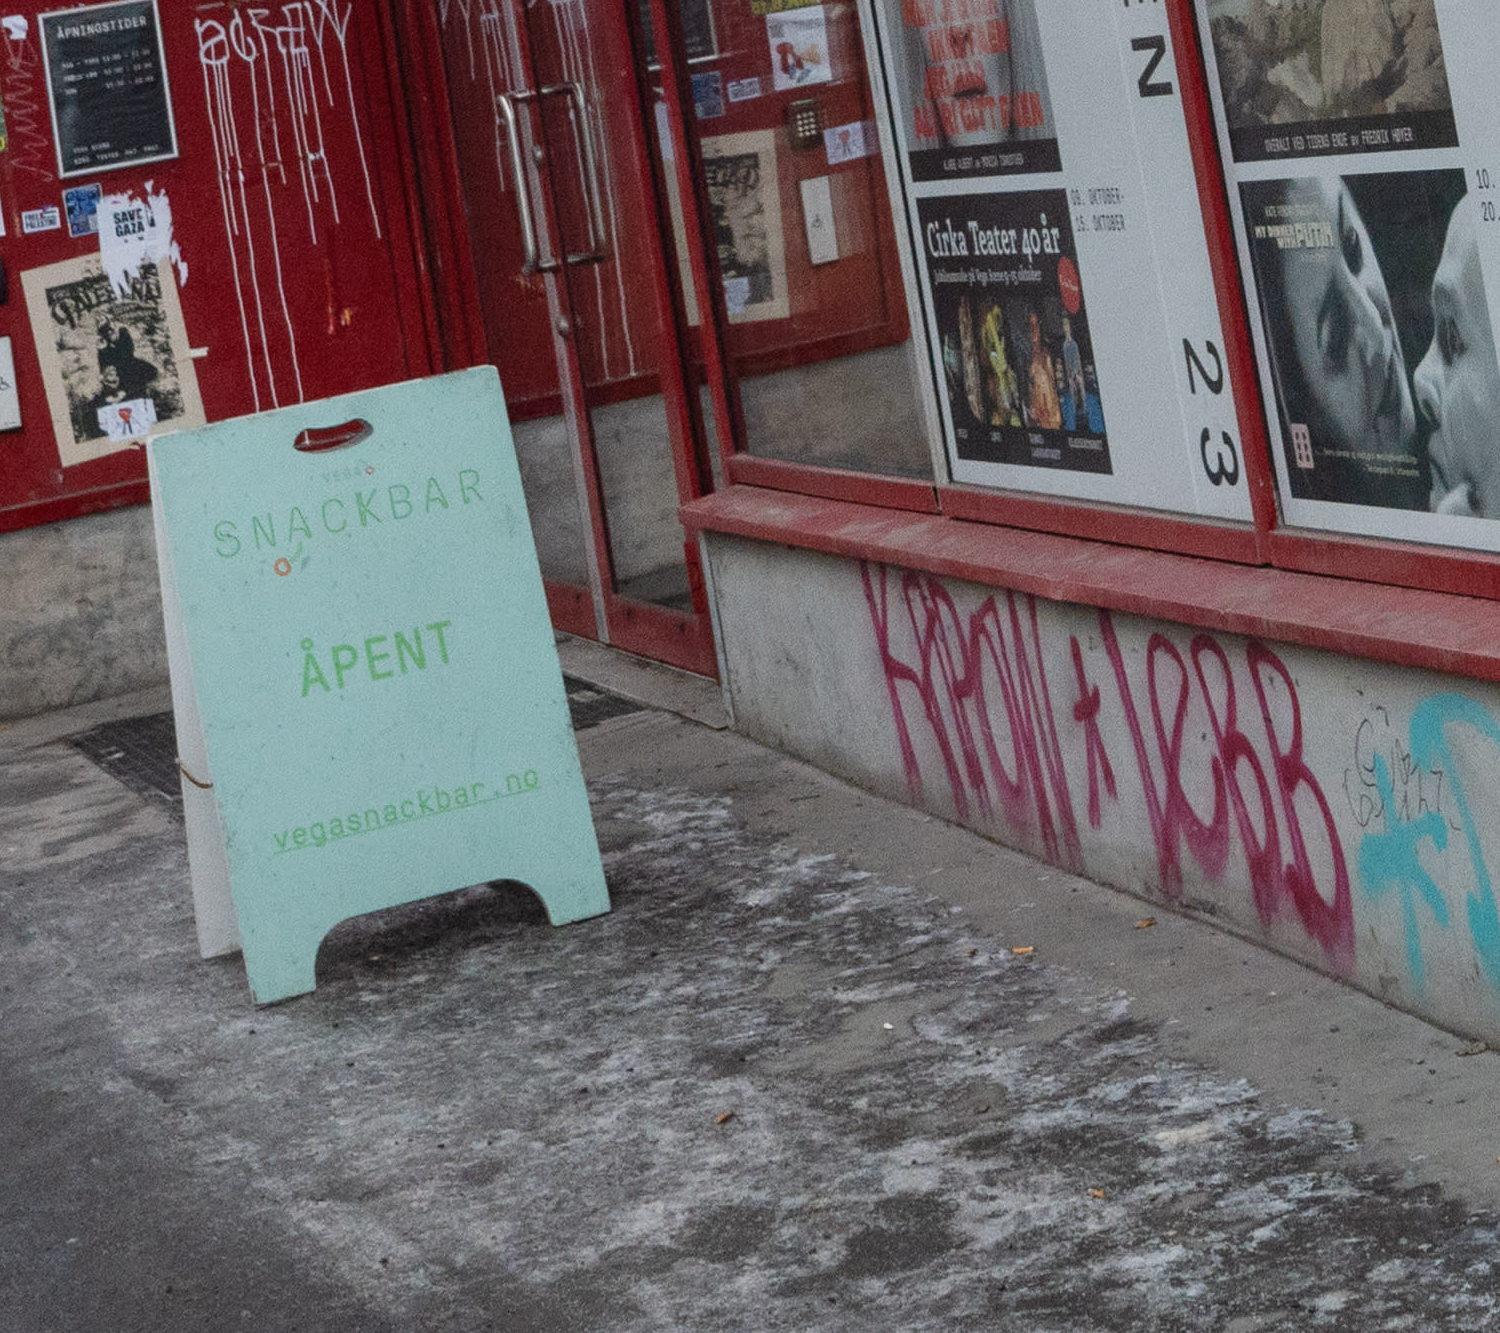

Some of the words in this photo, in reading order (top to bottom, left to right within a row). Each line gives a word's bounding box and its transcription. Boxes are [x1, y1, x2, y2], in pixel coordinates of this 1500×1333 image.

[56, 16, 148, 42] ÅPNINGSTIDER
[1475, 167, 1497, 190] 10.
[113, 208, 143, 225] SAVE
[115, 219, 146, 238] GAZA
[1091, 213, 1126, 232] OKTOBER
[926, 217, 969, 258] Cirka
[967, 219, 1017, 256] Teater
[1021, 227, 1041, 263] 40
[1040, 212, 1061, 254] år
[213, 467, 486, 559] SNACKBAR
[300, 620, 454, 698] ÅPENT
[272, 765, 542, 855] vegasnackbar.no
